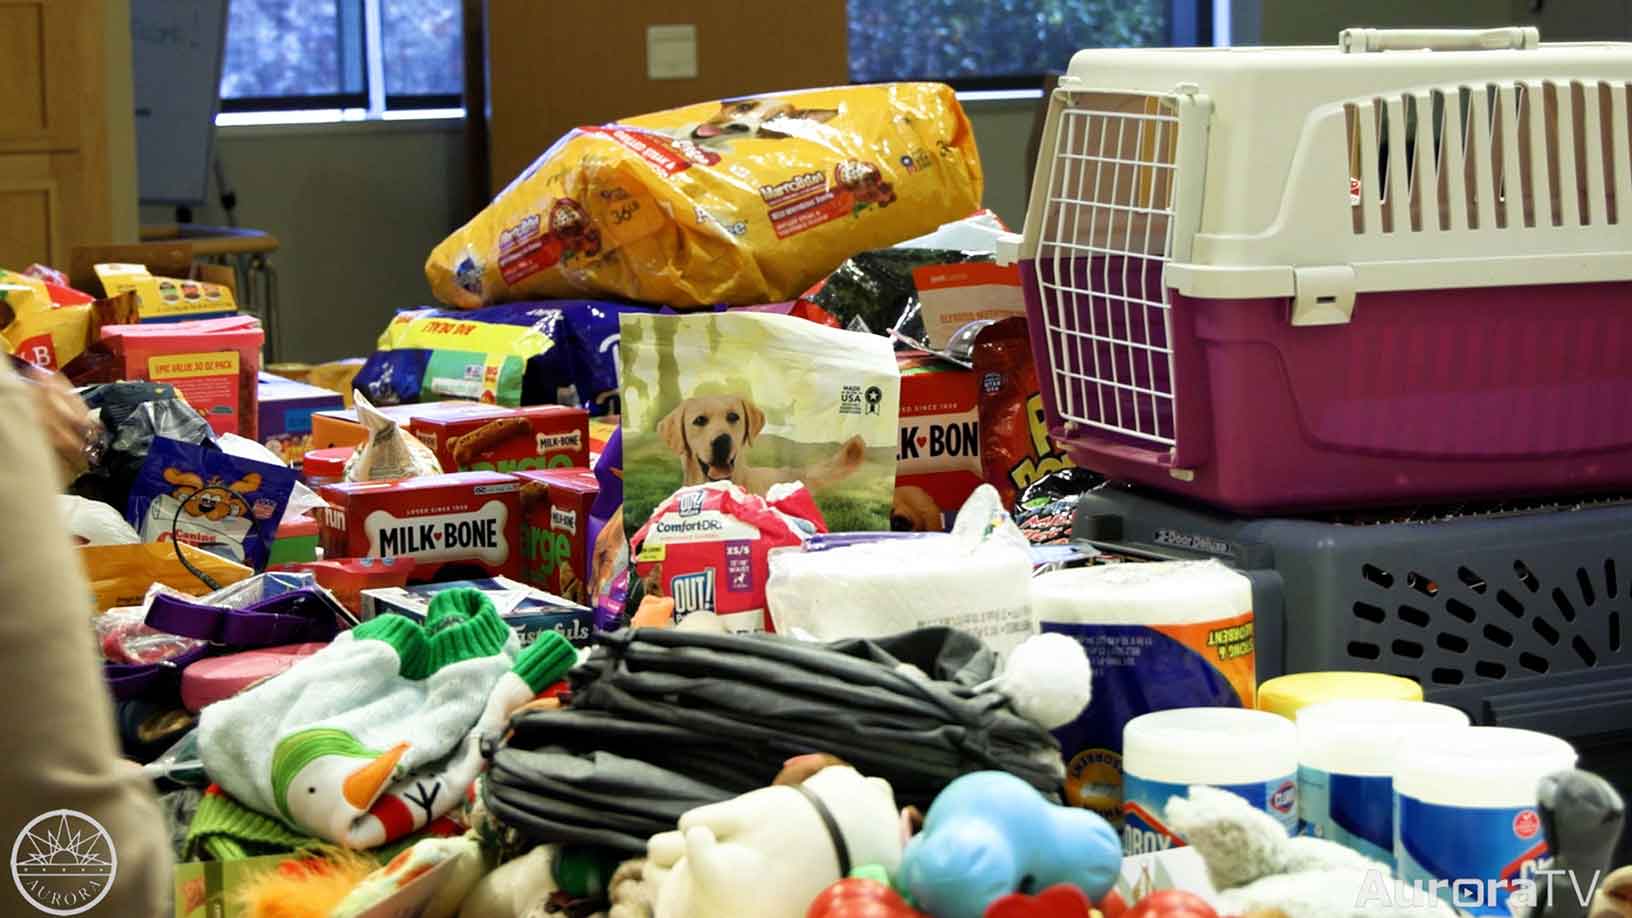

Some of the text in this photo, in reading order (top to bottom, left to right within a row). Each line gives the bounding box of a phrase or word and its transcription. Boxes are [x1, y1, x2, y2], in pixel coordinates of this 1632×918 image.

[841, 394, 862, 402] USA
[897, 421, 979, 461] K BON
[674, 569, 715, 613] OUT!
